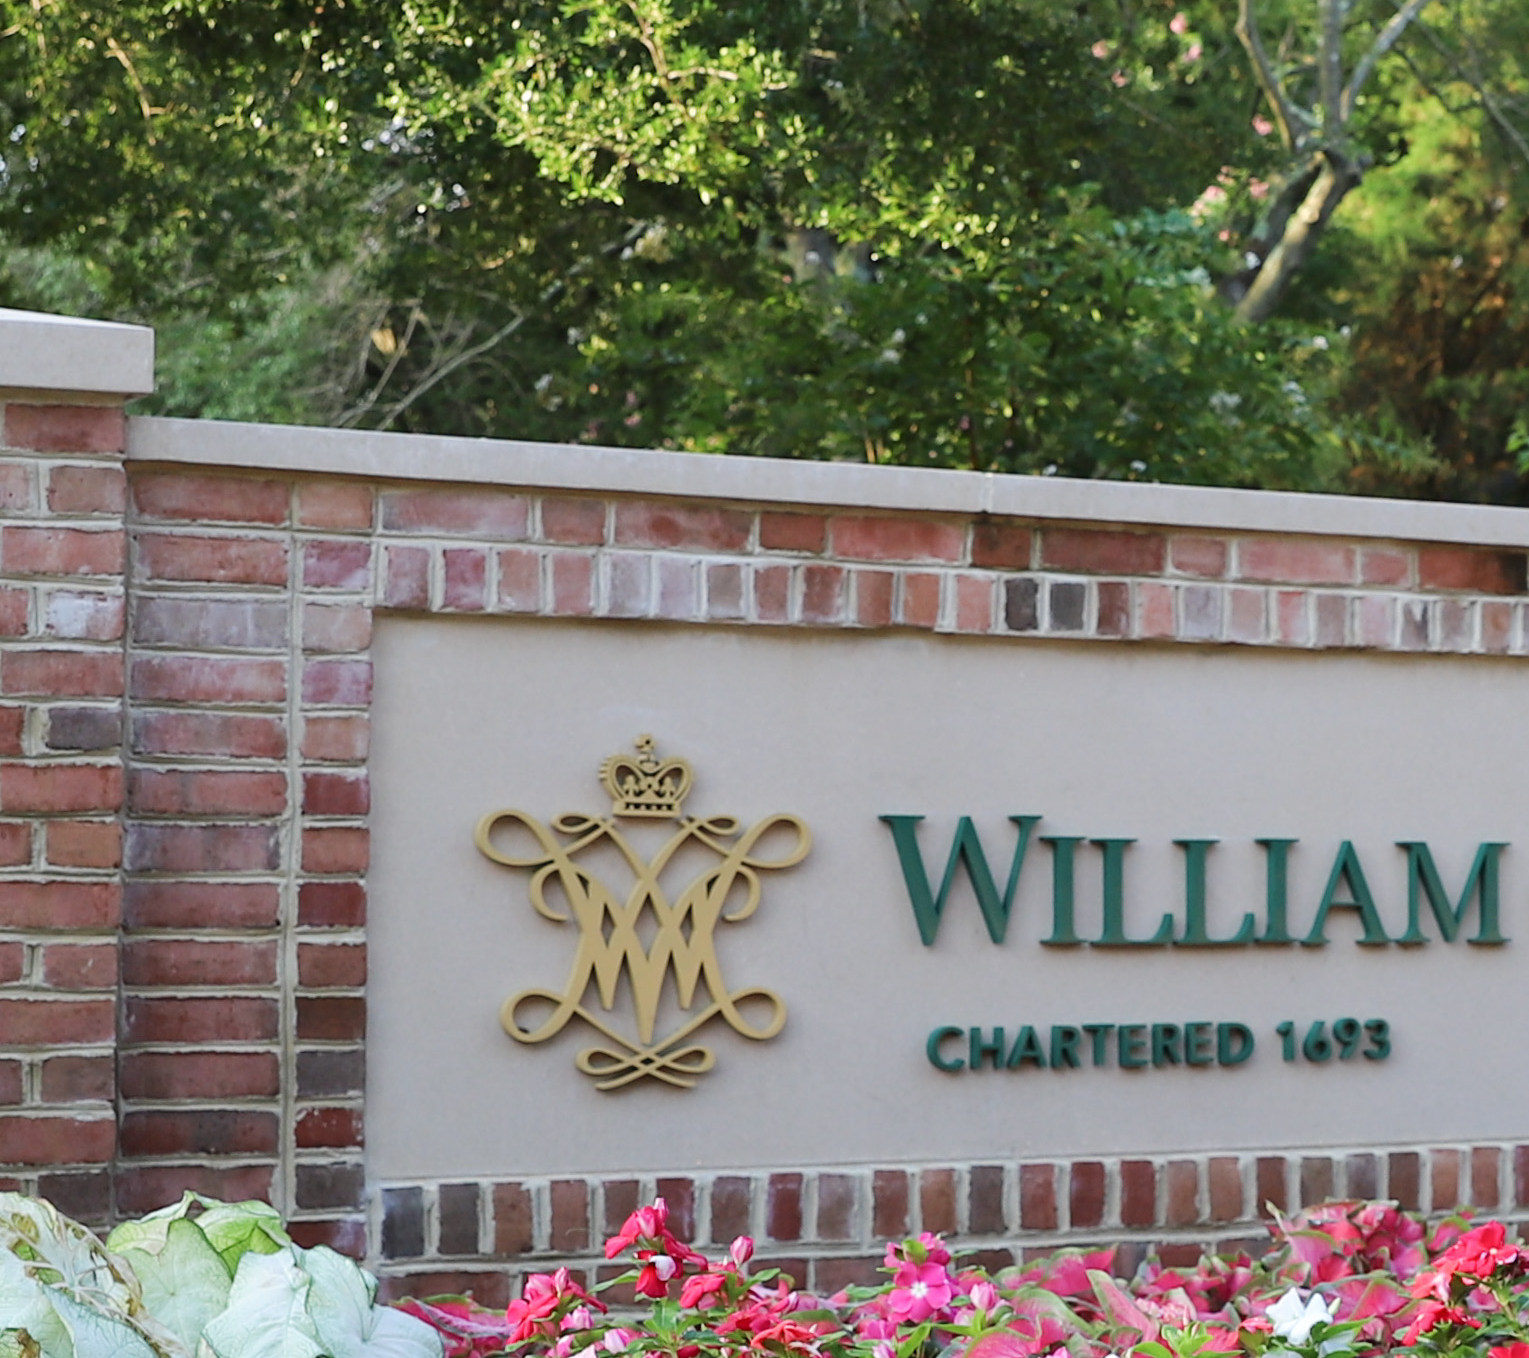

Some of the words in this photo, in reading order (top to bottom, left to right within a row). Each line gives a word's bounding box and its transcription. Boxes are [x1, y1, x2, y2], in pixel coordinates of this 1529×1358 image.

[878, 815, 1512, 946] WILLIAM
[926, 1022, 1255, 1072] CHARTERED
[1276, 1018, 1392, 1062] 1693
